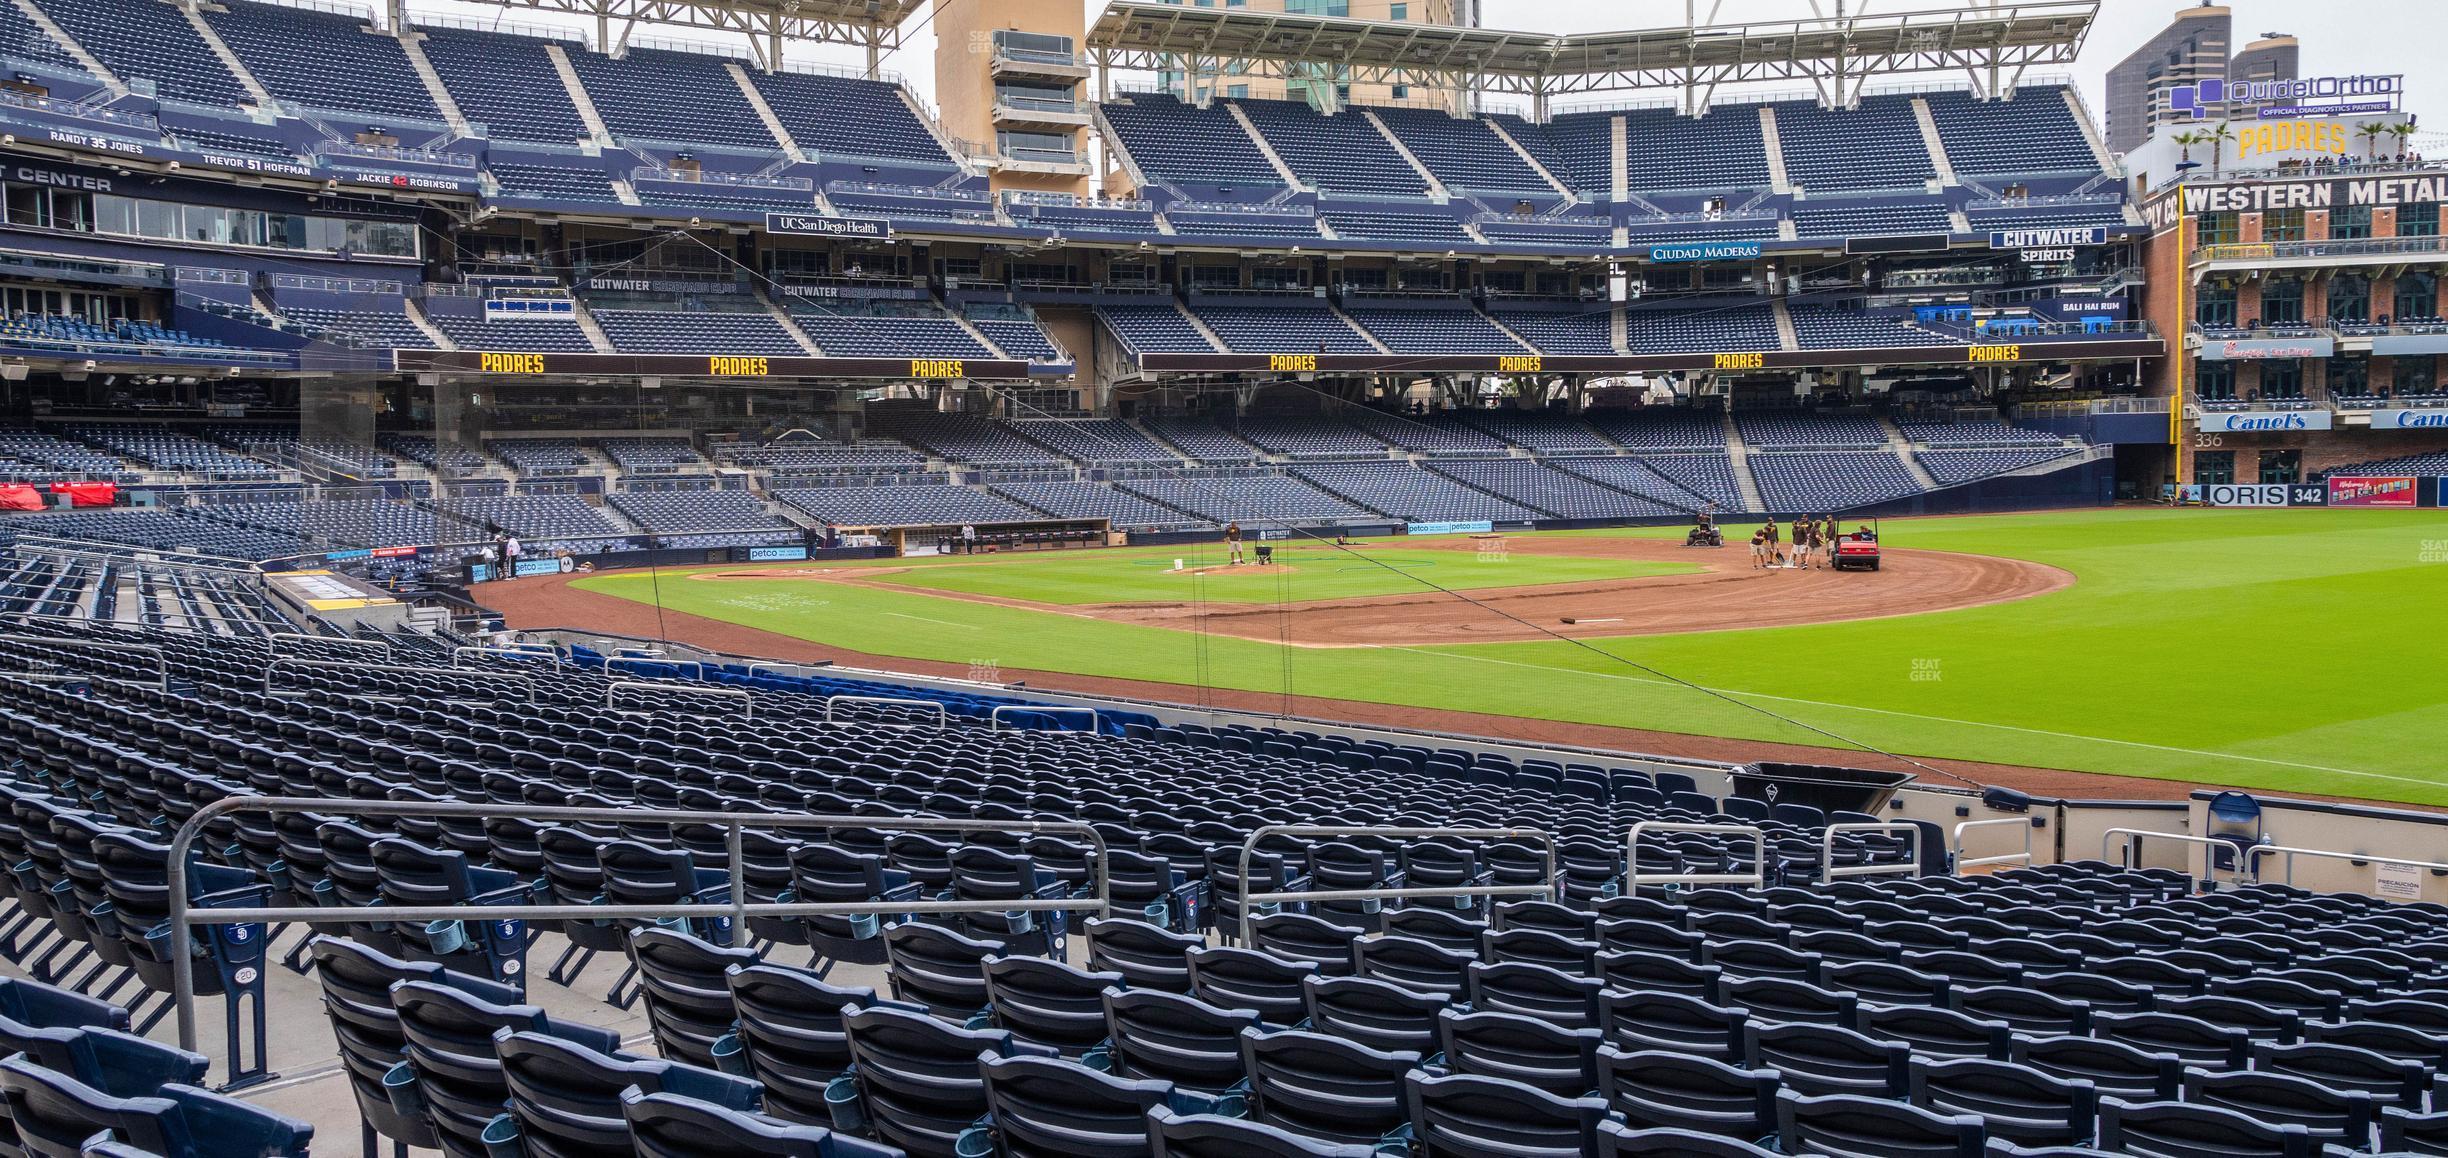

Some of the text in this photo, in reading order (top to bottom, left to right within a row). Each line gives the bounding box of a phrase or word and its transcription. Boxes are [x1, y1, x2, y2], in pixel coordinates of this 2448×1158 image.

[2231, 76, 2392, 104] QuidelOrtho
[2263, 103, 2387, 116] OFFICIAL DIAGNOSTICS PARTNER
[50, 131, 143, 154] RANDY 35 JONES
[2239, 120, 2346, 160] PADRES
[203, 155, 311, 176] TREVOR 51 HOFFMAN
[18, 167, 112, 192] CENTER
[356, 173, 458, 190] JACKIE 42 ROBINSON
[2183, 176, 2448, 212] WESTERN METAL
[780, 217, 878, 234] UC San Diego Health
[2003, 229, 2093, 247] CUTWATER
[1653, 246, 1758, 260] CIUDAD MADERAS
[2021, 249, 2075, 262] SPIRITS
[590, 278, 650, 291] CUTWATER
[785, 285, 838, 297] CUTWATER
[2063, 303, 2082, 311] BALI
[2101, 302, 2120, 310] RUM
[1715, 353, 1763, 369] PADRES
[1969, 345, 2020, 361] PADRES
[481, 353, 545, 373] PADRES
[710, 357, 768, 376] PADRES
[911, 360, 963, 377] PADRES
[1271, 355, 1316, 371] PADRES
[1500, 357, 1541, 371] PADRES
[2225, 413, 2306, 431] Canel's
[2194, 434, 2223, 448] 336
[2213, 486, 2285, 504] ORIS
[2294, 488, 2321, 503] 342
[1409, 525, 1428, 533] petco
[1451, 523, 1470, 531] petco
[752, 549, 777, 559] petco
